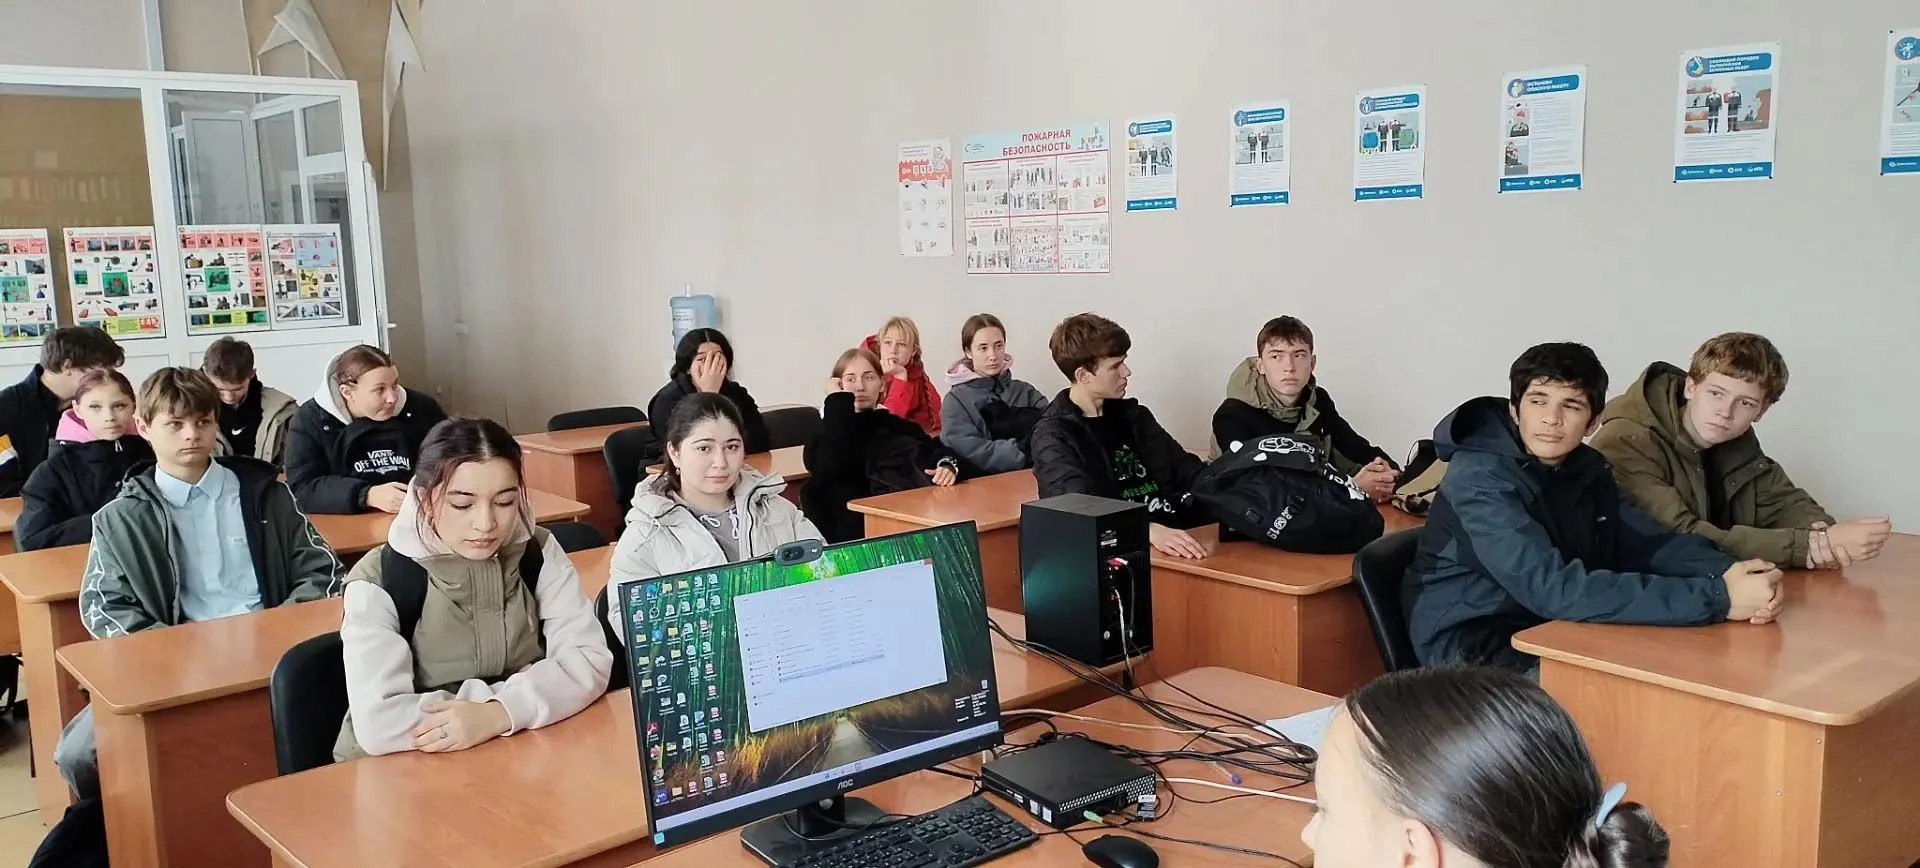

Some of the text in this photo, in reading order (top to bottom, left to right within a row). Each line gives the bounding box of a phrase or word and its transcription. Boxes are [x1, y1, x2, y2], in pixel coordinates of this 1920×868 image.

[1022, 129, 1071, 142] ПОЖАРНАЯ
[1002, 142, 1071, 156] БЕЗОПАСНОСТЬ
[367, 450, 393, 459] VANS
[370, 457, 389, 467] THE
